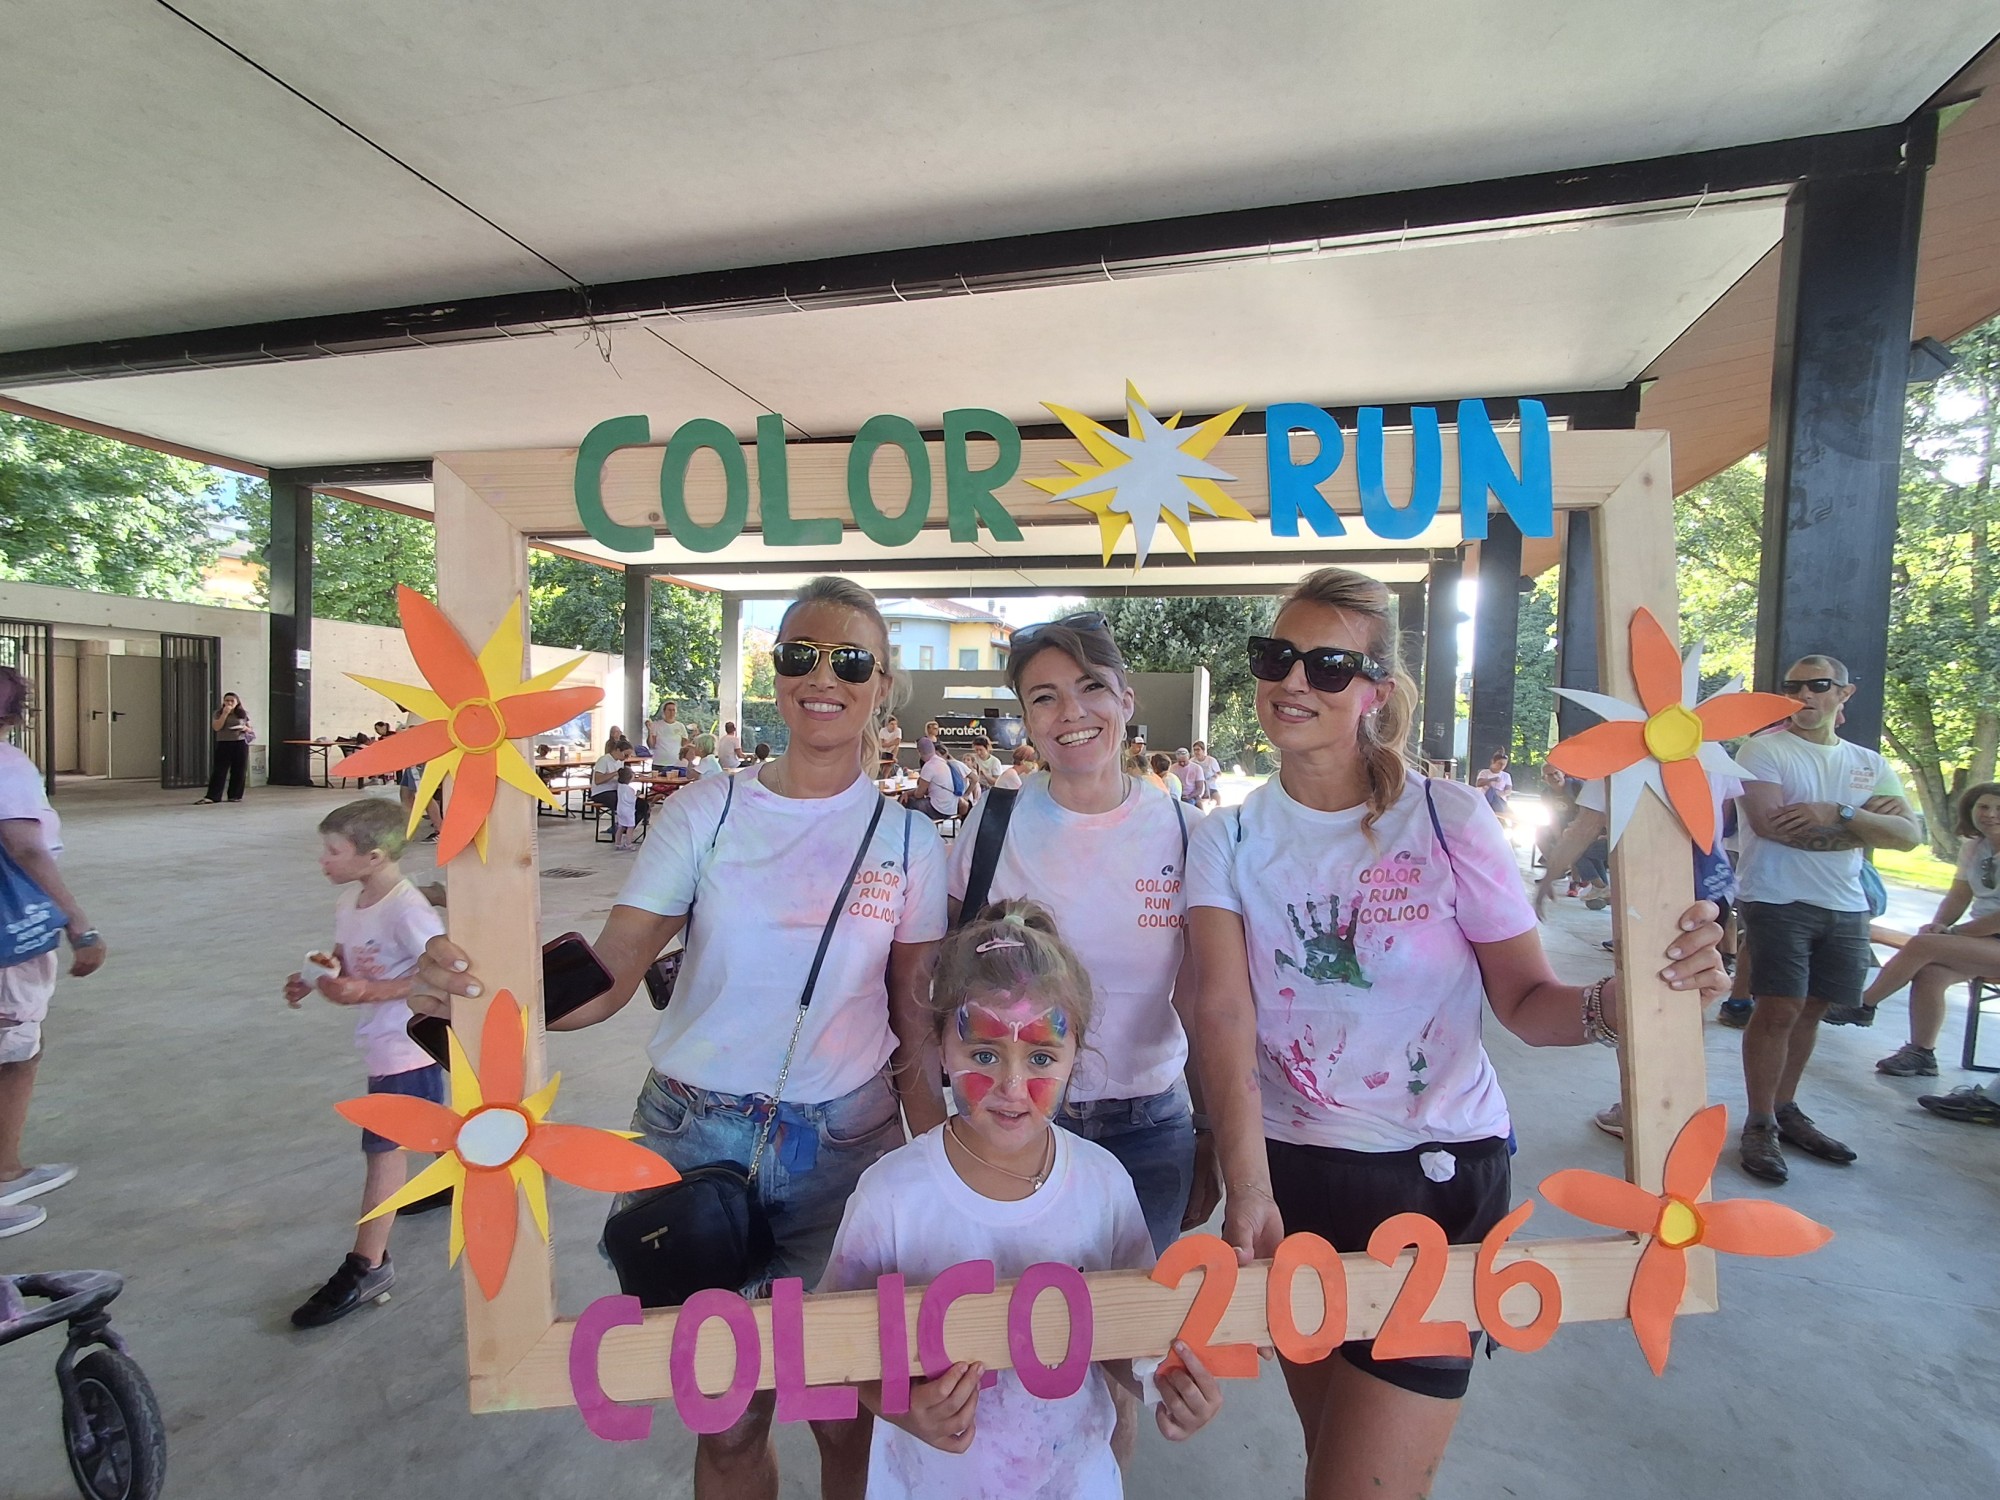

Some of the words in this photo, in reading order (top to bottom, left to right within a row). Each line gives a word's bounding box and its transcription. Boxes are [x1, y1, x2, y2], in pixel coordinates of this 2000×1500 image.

[574, 407, 1025, 553] COLOR
[1265, 398, 1554, 540] RUN
[939, 725, 987, 736] noratech
[1359, 867, 1421, 884] COLOR
[1135, 878, 1181, 893] COLOR
[859, 887, 890, 902] RUN
[1368, 887, 1408, 903] RUN
[1144, 896, 1171, 911] RUN
[1137, 913, 1185, 929] COLICO
[1360, 903, 1430, 925] COLICO
[568, 1258, 1094, 1442] COLICO
[1148, 1198, 1563, 1379] 2026
